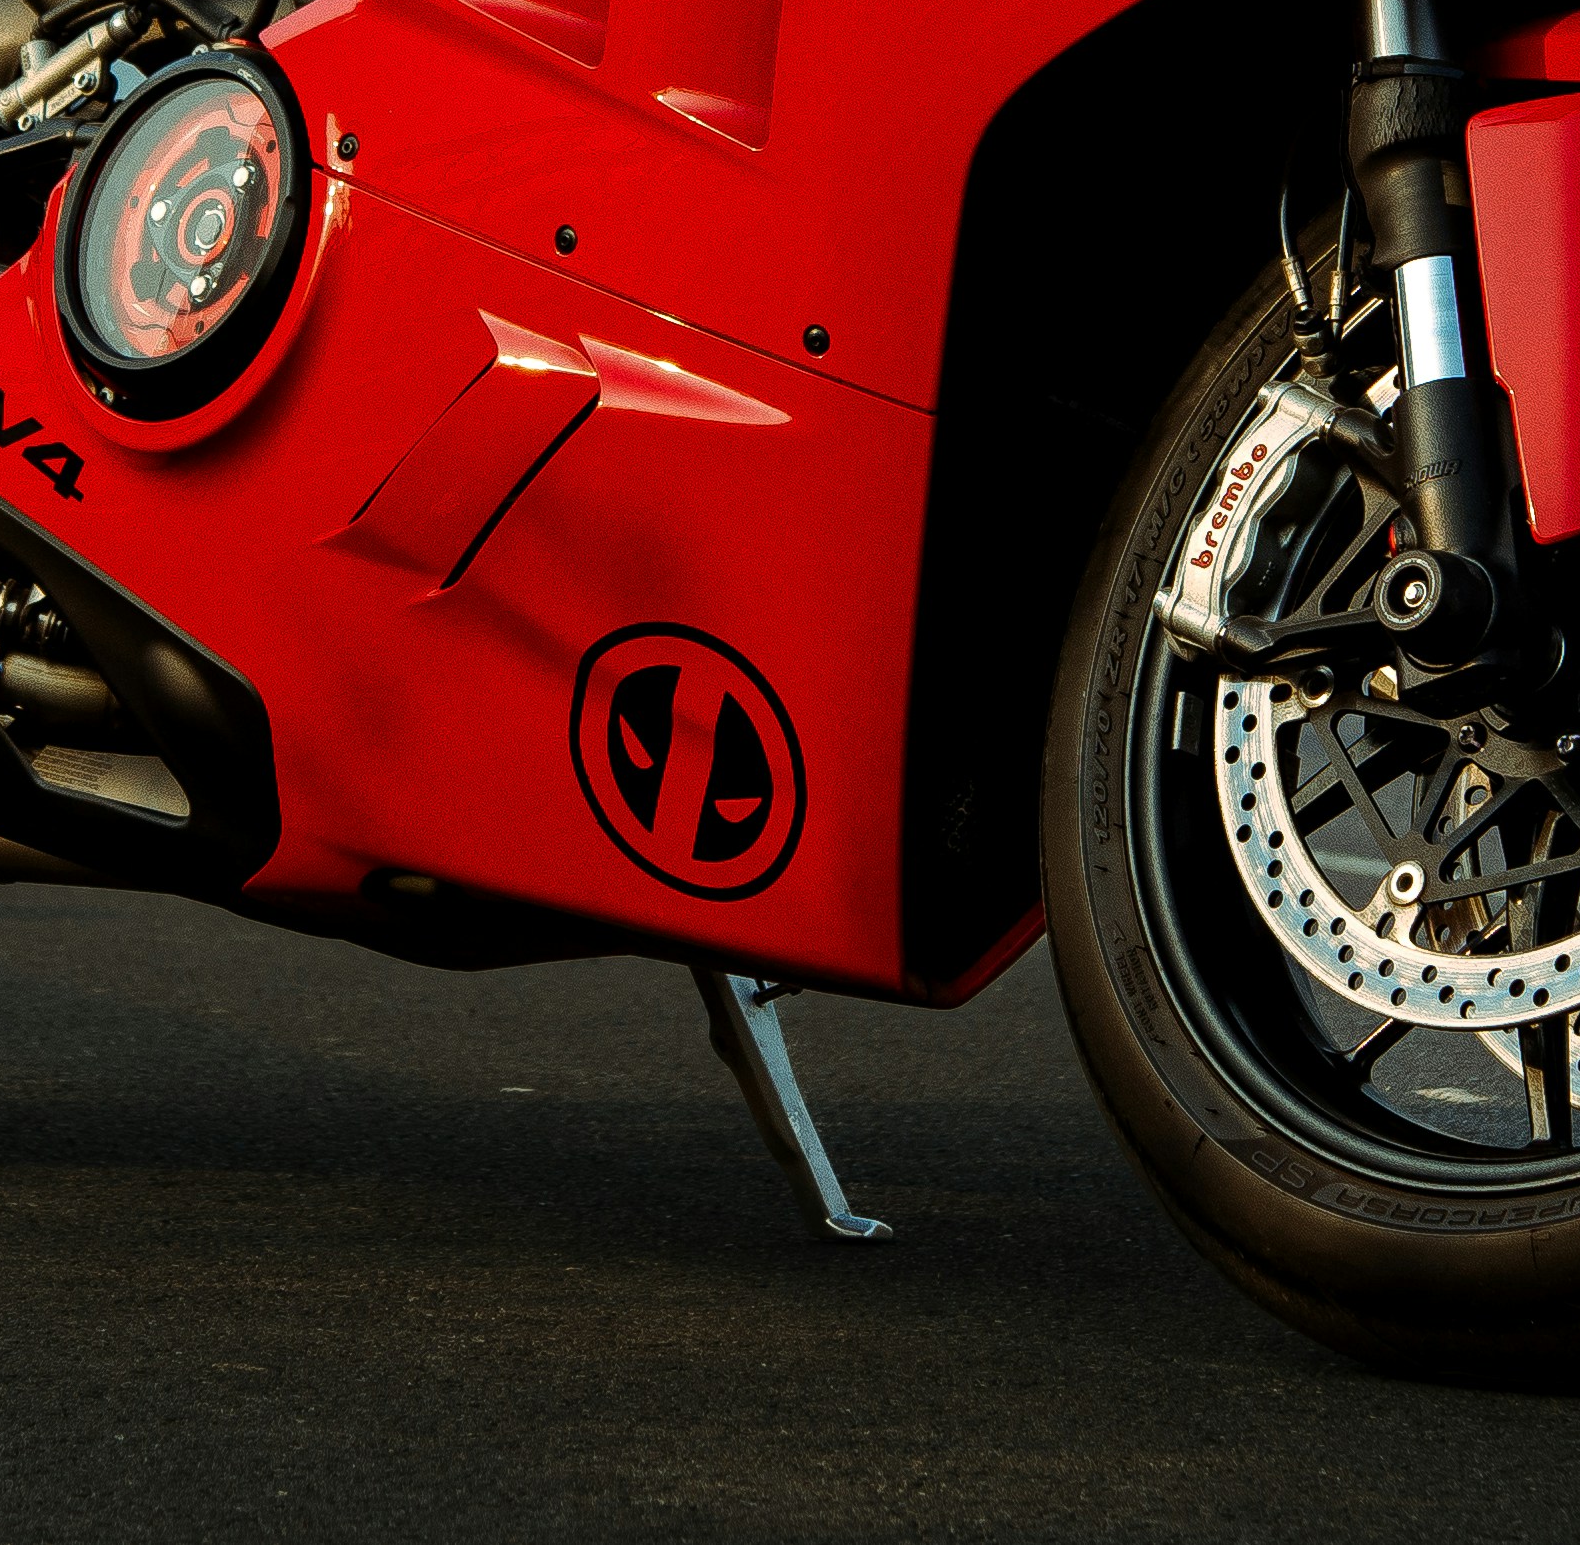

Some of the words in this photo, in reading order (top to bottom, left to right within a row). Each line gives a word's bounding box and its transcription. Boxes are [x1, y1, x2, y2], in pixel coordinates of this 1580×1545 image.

[1190, 442, 1268, 570] brembo
[1092, 708, 1113, 846] 120/70
[1104, 627, 1127, 686] ZR
[1124, 561, 1145, 606] 17
[1251, 1149, 1315, 1190] SP
